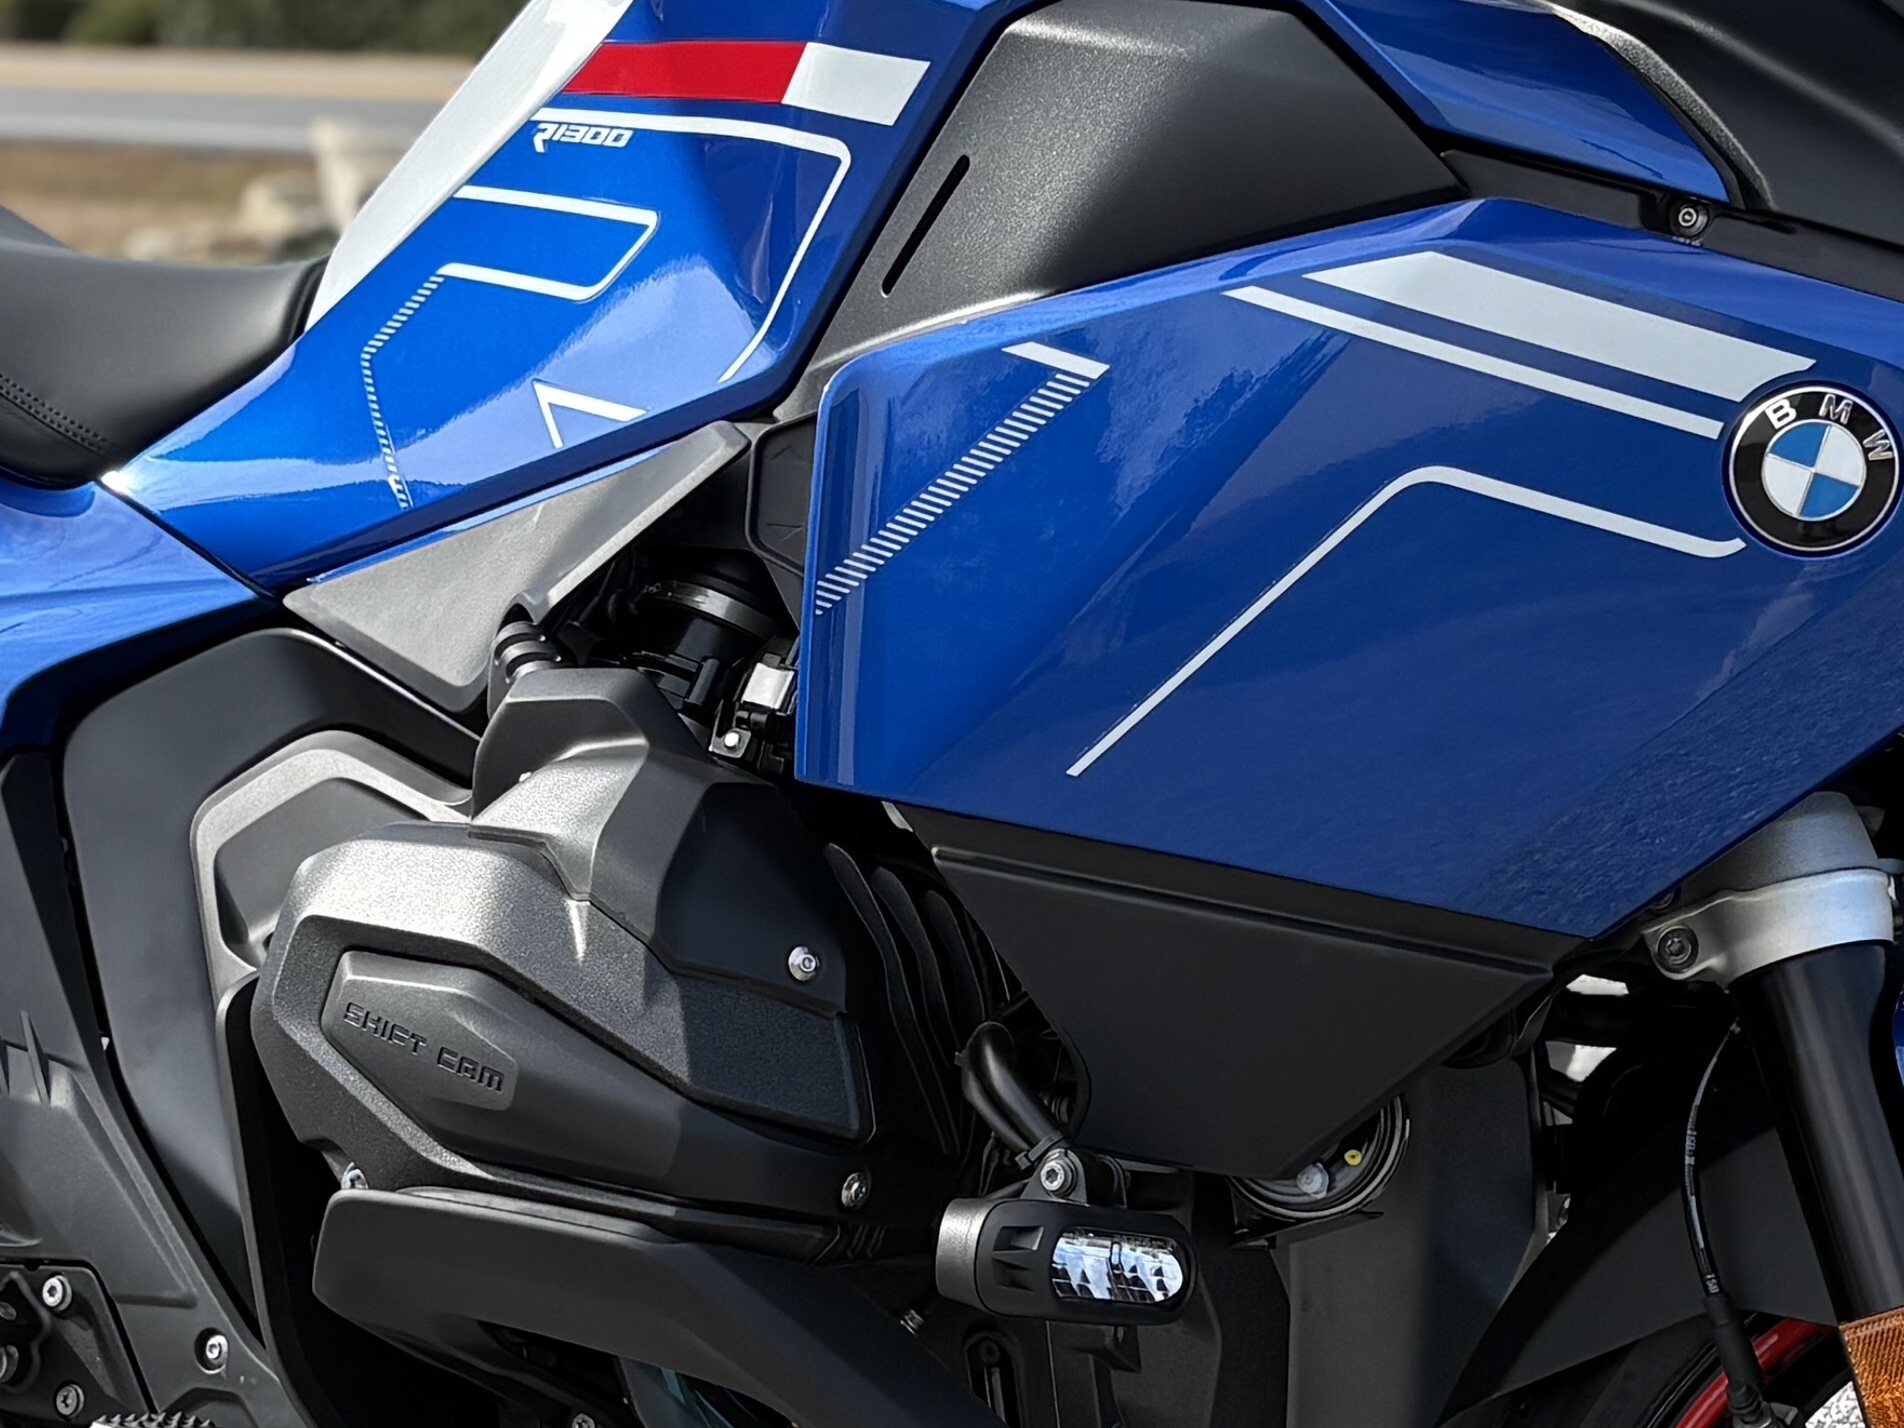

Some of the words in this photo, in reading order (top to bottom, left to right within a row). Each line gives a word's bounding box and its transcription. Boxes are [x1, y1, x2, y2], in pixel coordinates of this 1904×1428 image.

[533, 123, 634, 153] R1300
[1765, 393, 1895, 461] BMW
[343, 1001, 427, 1056] SHIFT
[436, 1044, 506, 1093] CAM
